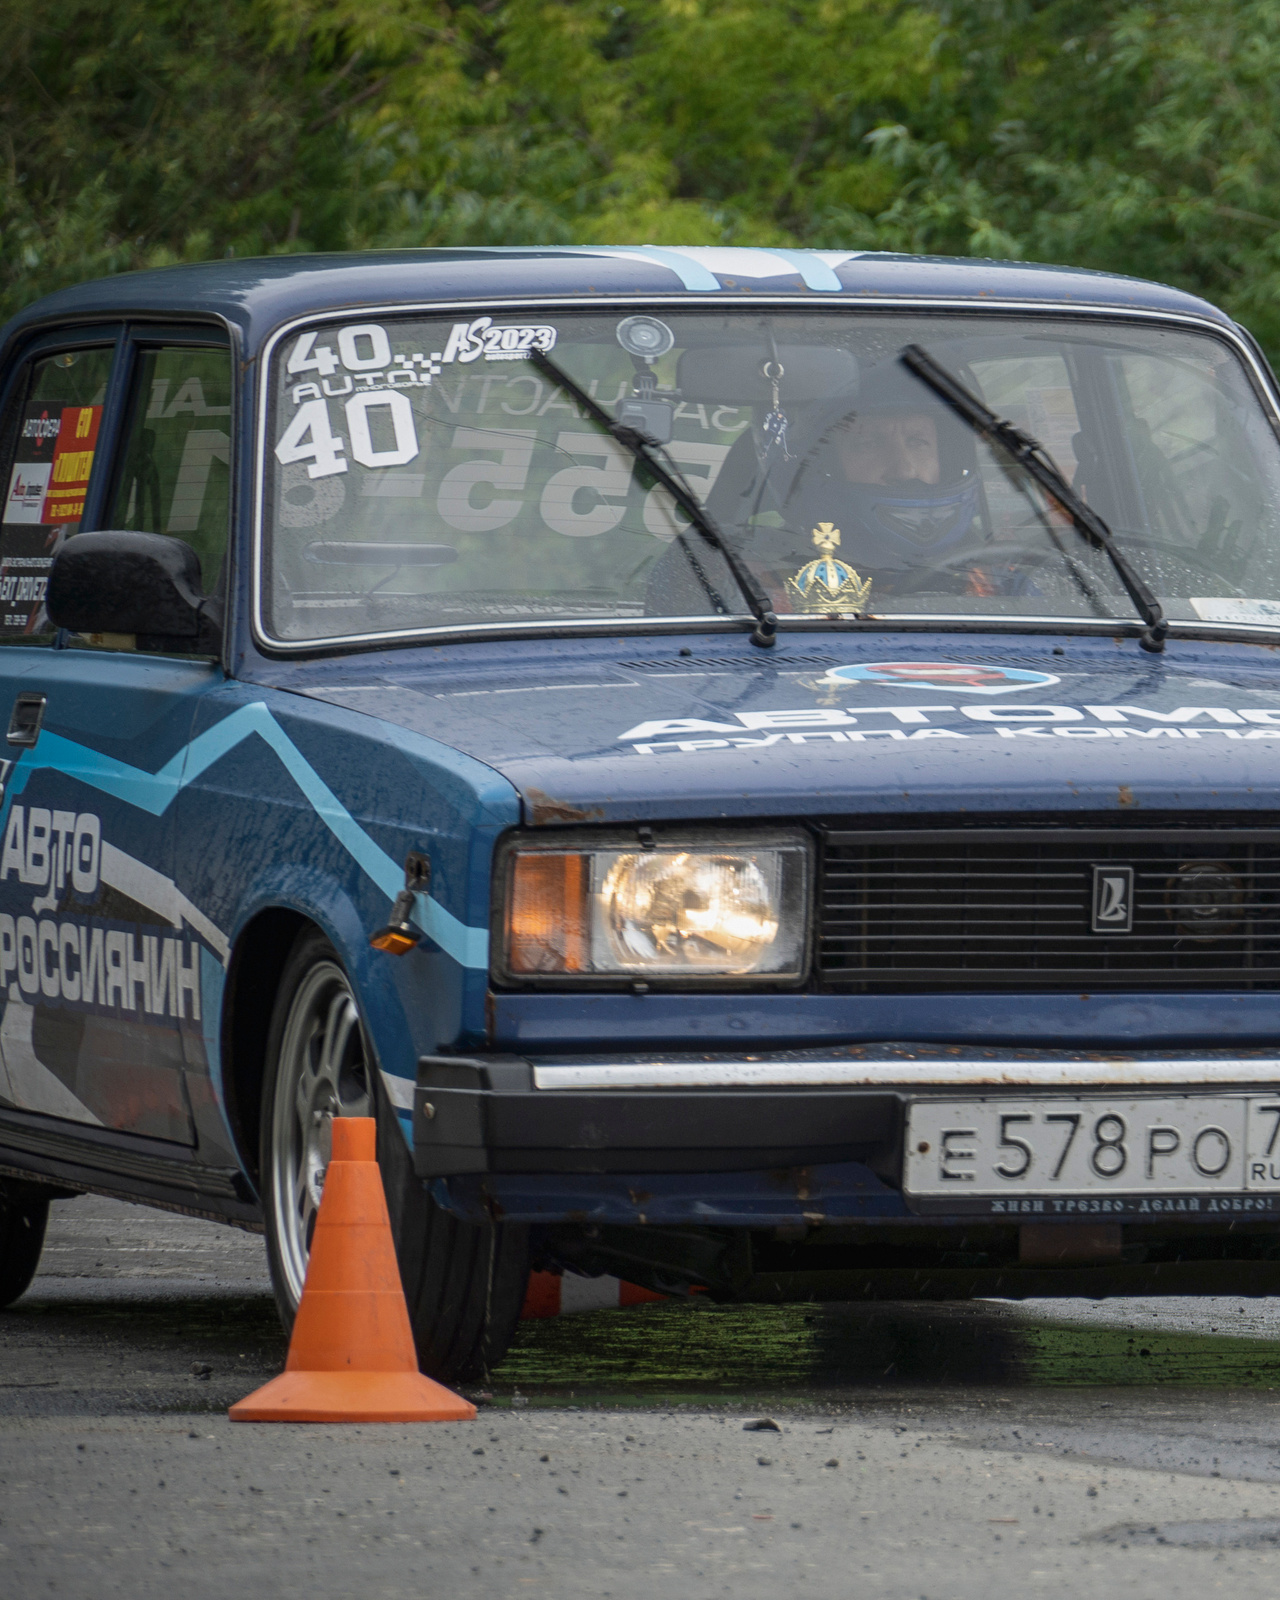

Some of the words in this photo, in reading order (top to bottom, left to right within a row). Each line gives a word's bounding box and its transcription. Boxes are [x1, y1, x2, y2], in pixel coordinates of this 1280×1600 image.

[287, 324, 392, 376] 40
[485, 328, 552, 350] 2023
[292, 369, 417, 404] AUTO
[274, 389, 419, 479] 40
[632, 727, 971, 755] ГРУППА
[0, 804, 100, 893] АВТО
[0, 912, 201, 1021] РОССИЯНИН
[990, 1199, 1045, 1213] ЖИВИ
